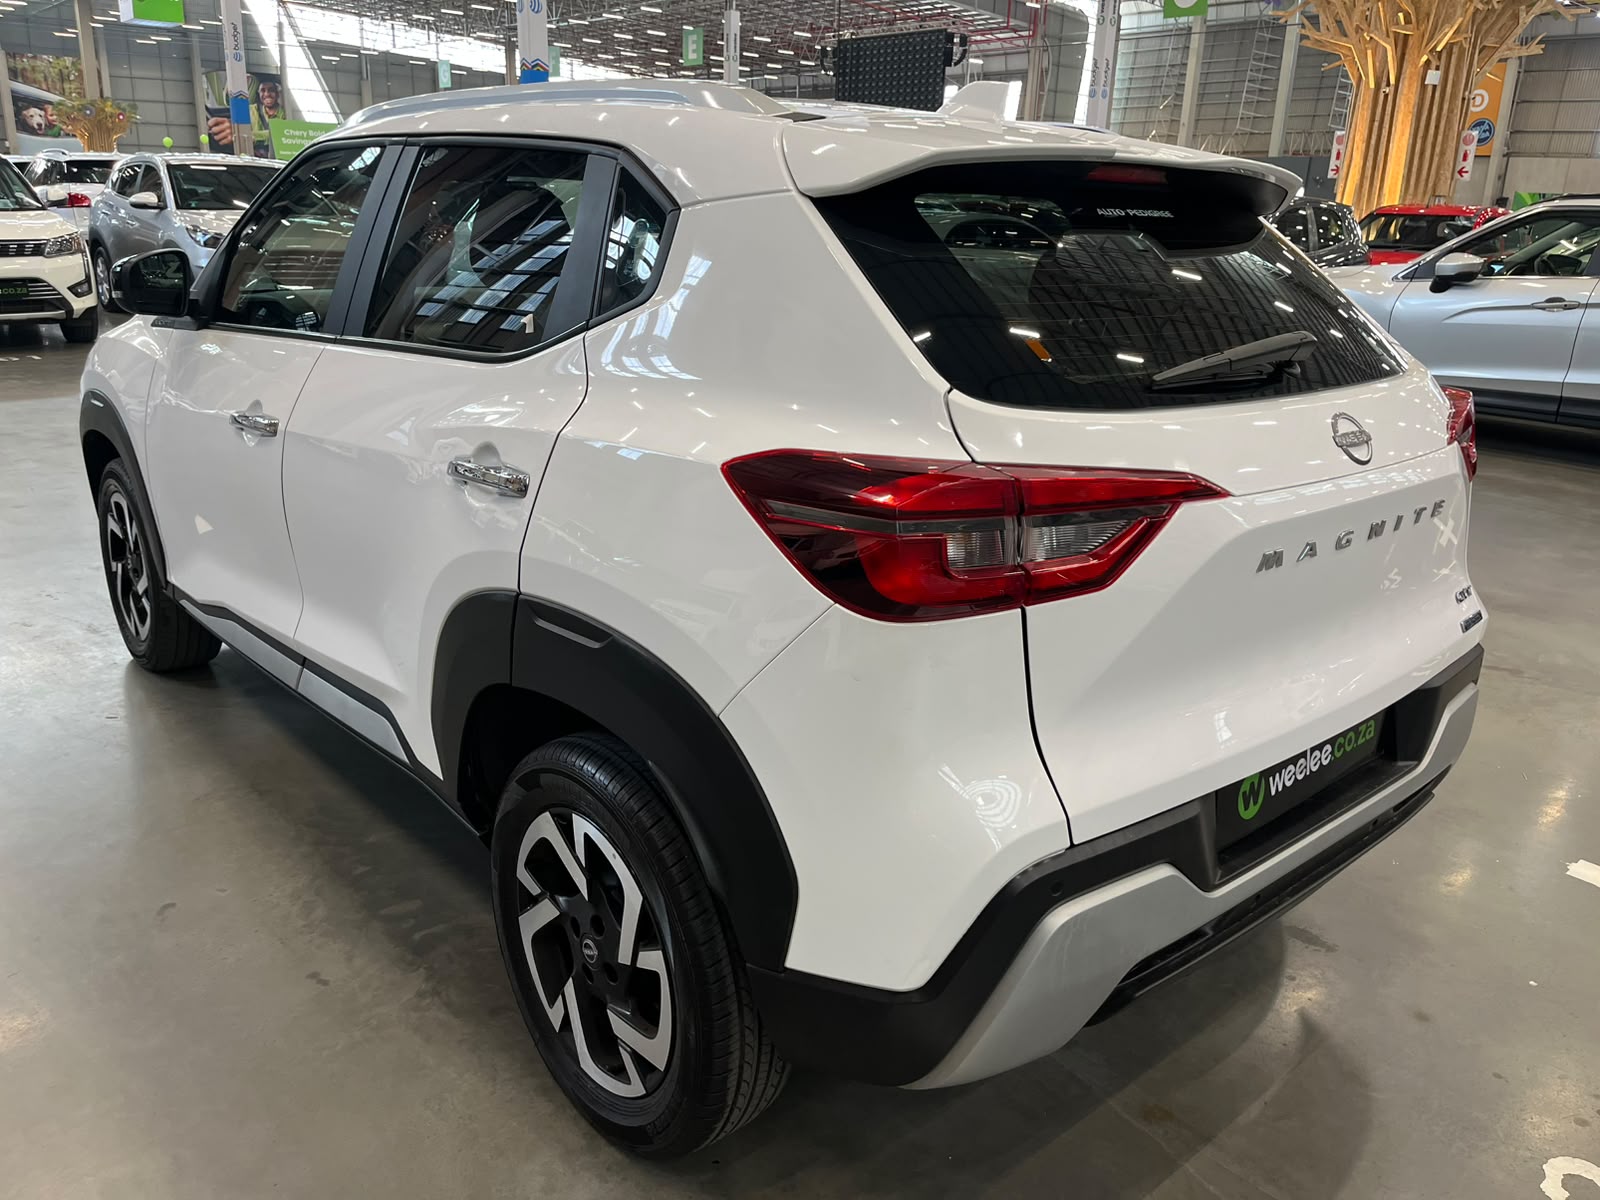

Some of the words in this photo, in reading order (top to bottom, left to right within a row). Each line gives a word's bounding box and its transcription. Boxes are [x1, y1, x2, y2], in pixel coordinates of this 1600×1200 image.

[230, 21, 240, 51] budget
[688, 34, 697, 60] E
[1090, 57, 1099, 87] budget
[283, 129, 308, 138] Chery
[1097, 207, 1126, 217] AUTO
[1256, 500, 1446, 573] MAGNITE
[1269, 719, 1376, 797] weelee.co.za
